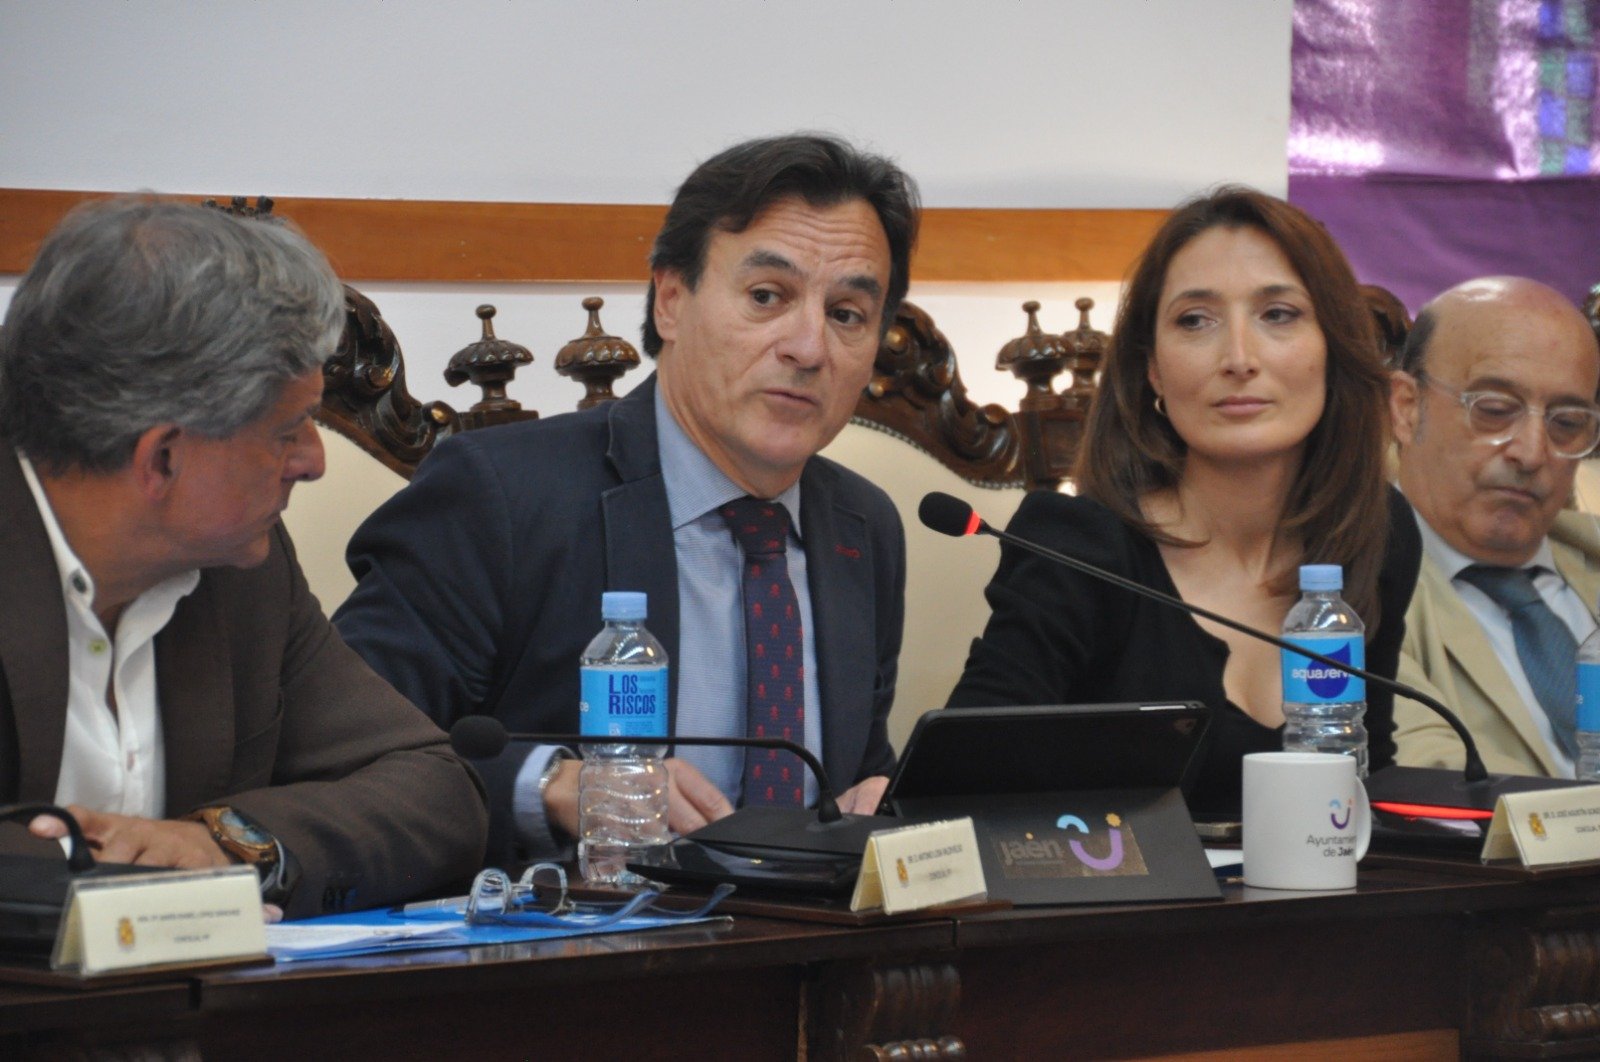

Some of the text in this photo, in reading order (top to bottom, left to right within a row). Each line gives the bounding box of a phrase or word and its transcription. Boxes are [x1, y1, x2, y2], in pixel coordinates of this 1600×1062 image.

[1292, 668, 1358, 682] aquaserv
[609, 674, 638, 694] LOS
[609, 695, 656, 715] RISCOS
[1323, 847, 1337, 857] de
